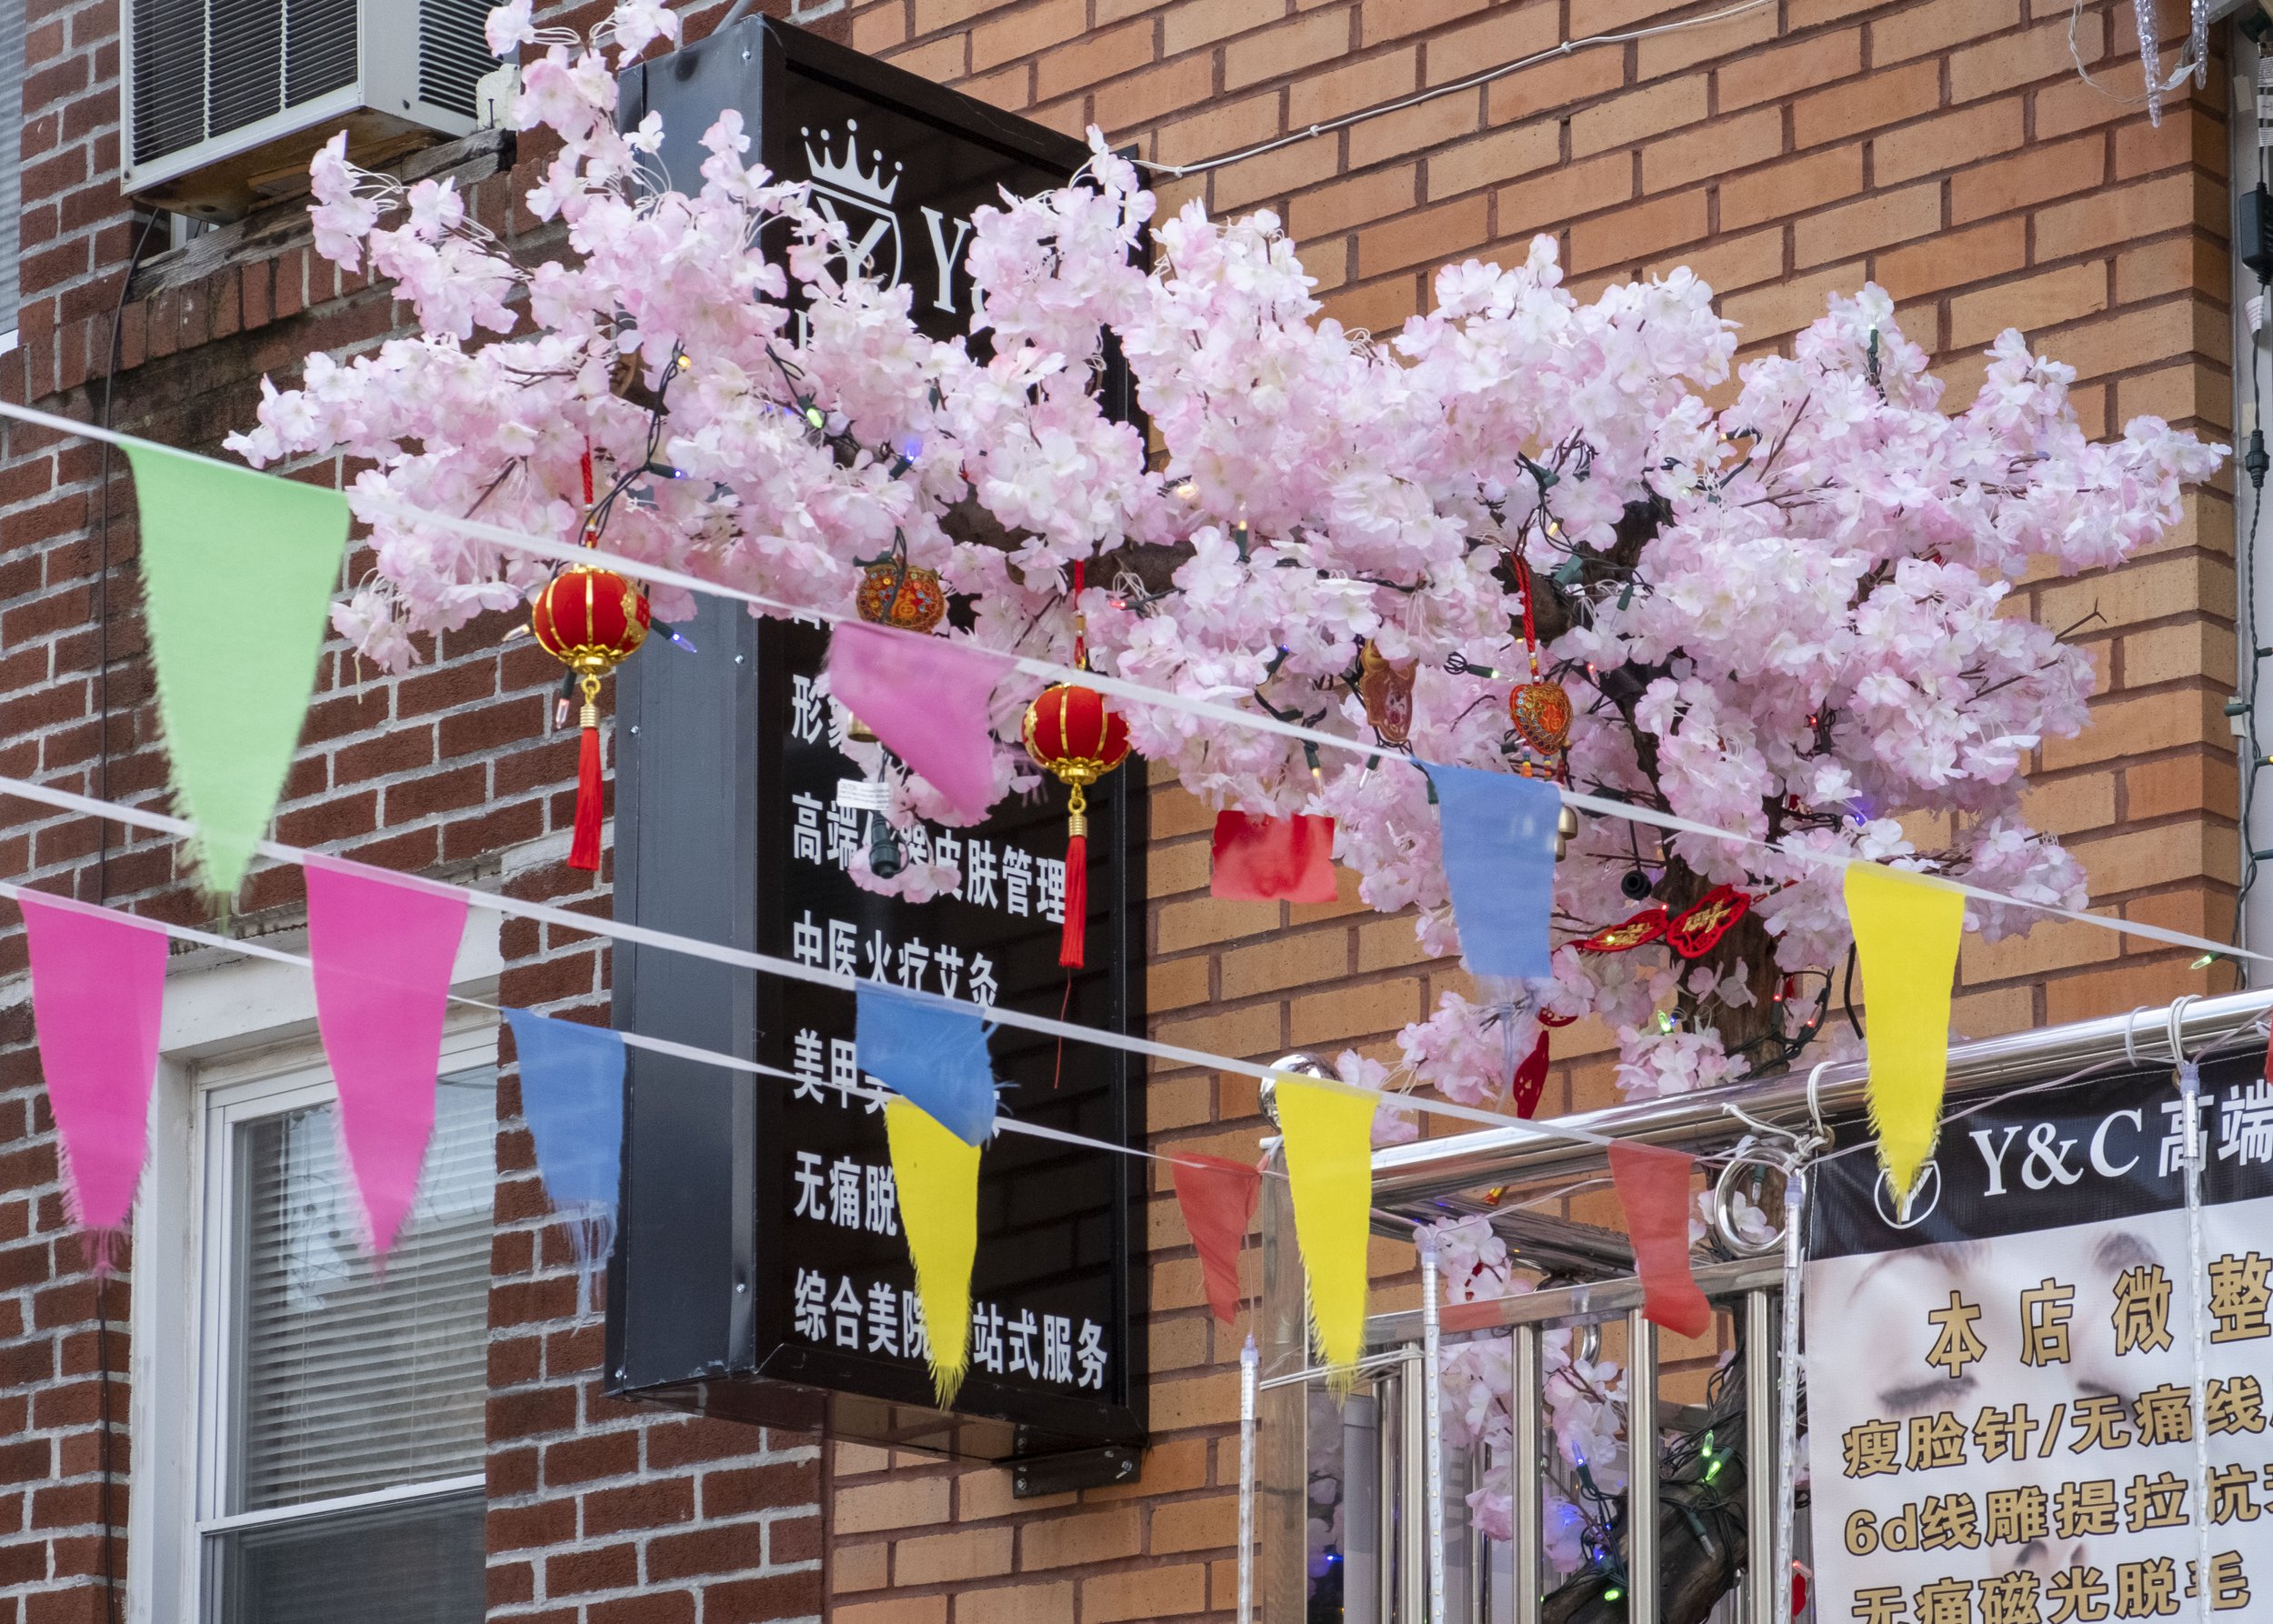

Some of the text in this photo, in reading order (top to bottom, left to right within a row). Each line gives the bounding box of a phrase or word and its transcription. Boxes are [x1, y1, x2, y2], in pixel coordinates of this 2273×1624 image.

[793, 909, 998, 1008] 中医火疗艾灸
[1968, 1108, 2143, 1198] Y&C
[794, 1267, 1108, 1390] 综合美院站式服务
[1842, 1374, 2273, 1479] 瘦脸针/无痛线
[1844, 1462, 2273, 1557] 6d线雕提拉抗
